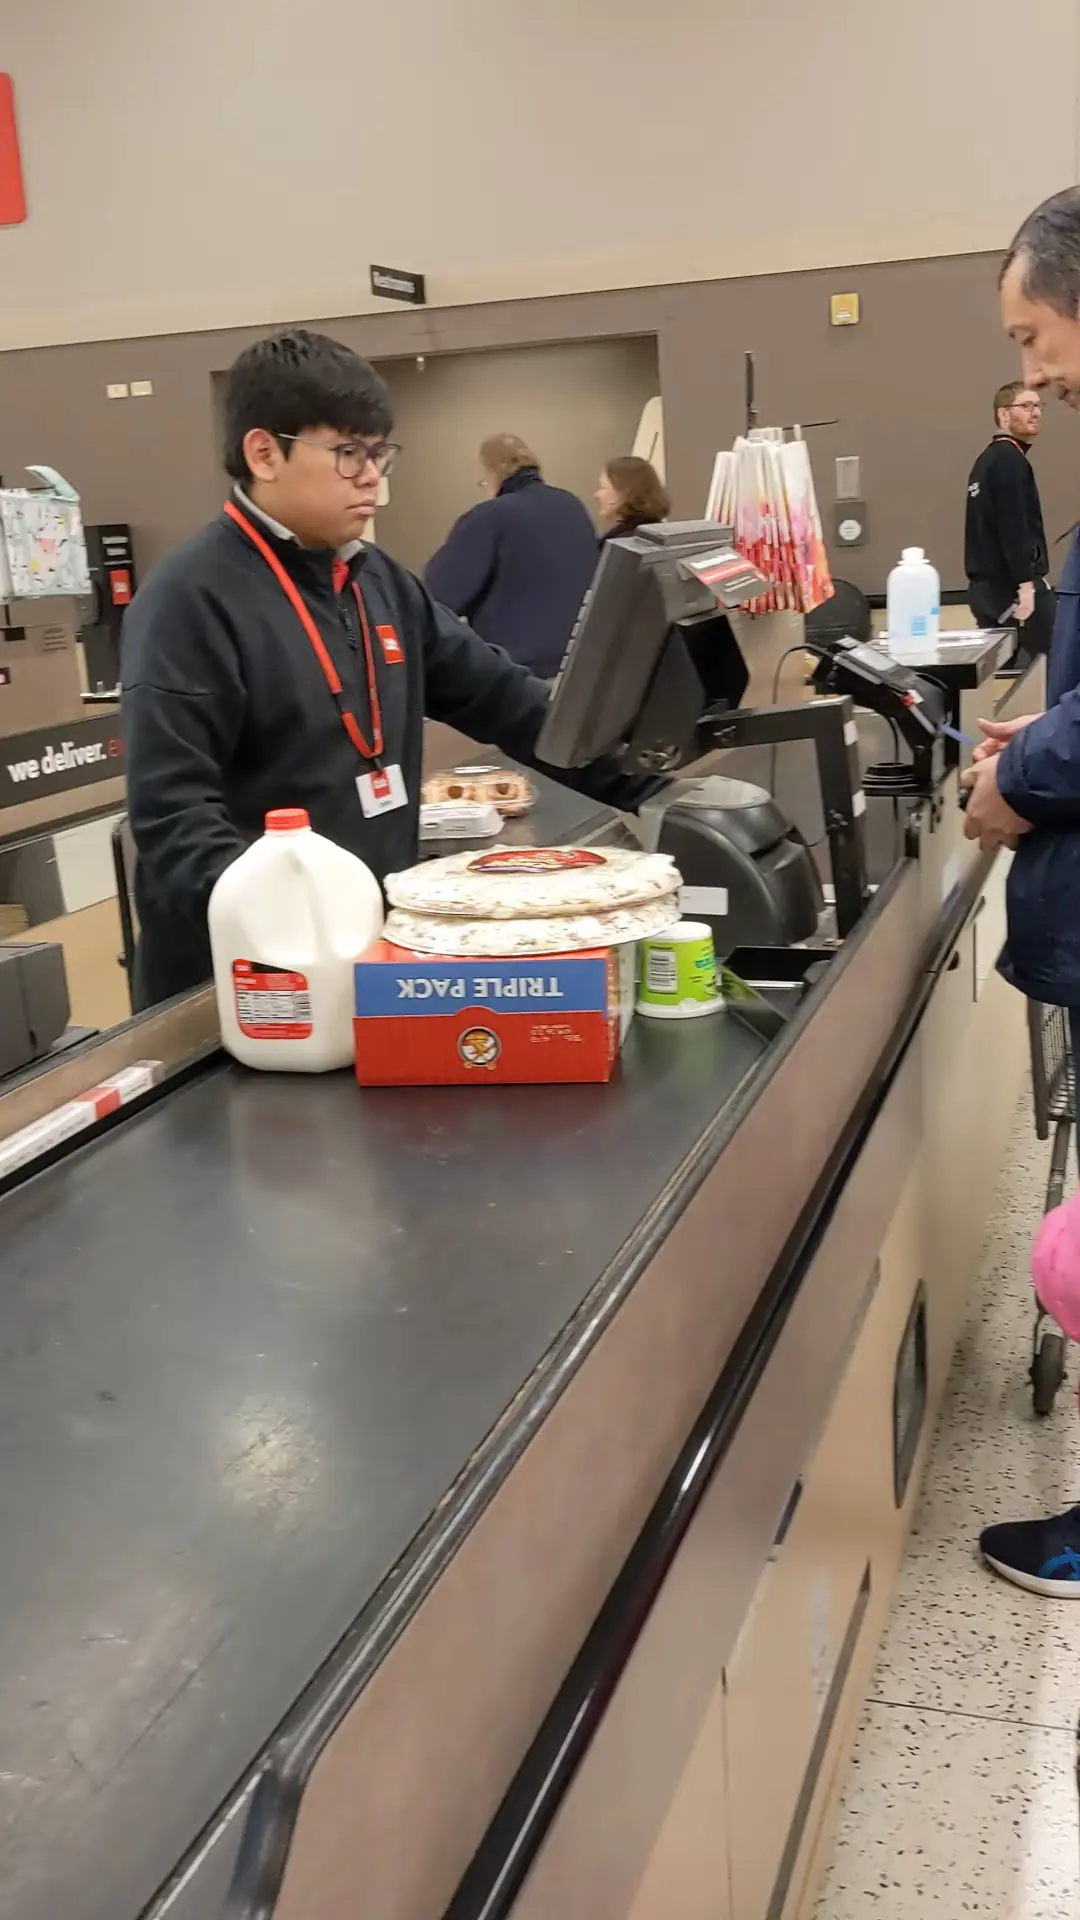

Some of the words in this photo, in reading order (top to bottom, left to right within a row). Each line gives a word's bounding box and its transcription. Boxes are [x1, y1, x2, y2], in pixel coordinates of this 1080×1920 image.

[7, 759, 40, 783] we
[41, 741, 107, 775] deliver.
[396, 978, 465, 998] PACK
[473, 977, 564, 997] TRIPLE
